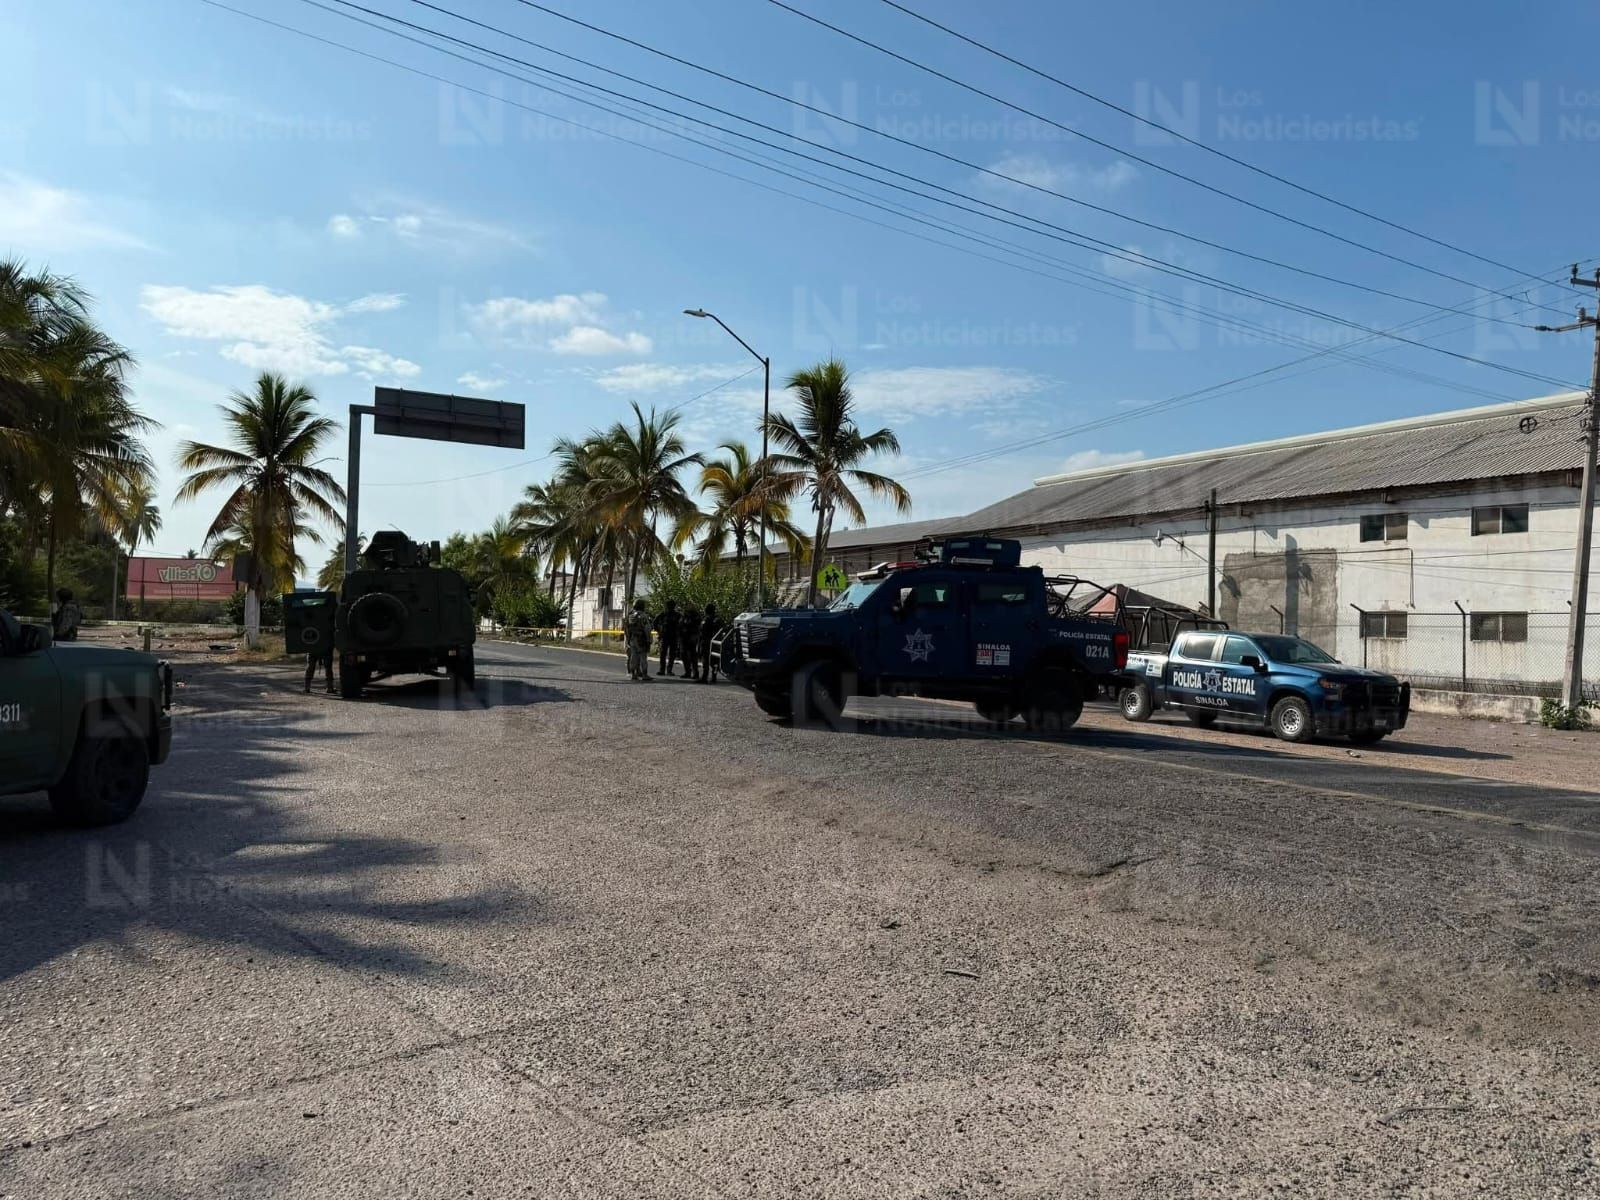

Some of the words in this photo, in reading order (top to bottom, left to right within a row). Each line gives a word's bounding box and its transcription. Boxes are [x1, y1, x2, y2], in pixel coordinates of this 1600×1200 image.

[1059, 630, 1084, 640] POLICÍA
[977, 643, 1011, 651] SINALOA
[1085, 645, 1110, 659] 021A
[1172, 669, 1202, 689] POLICÍA
[1222, 680, 1256, 696] ESTATAL
[1195, 695, 1228, 707] SINALOA
[0, 703, 21, 723] 311
